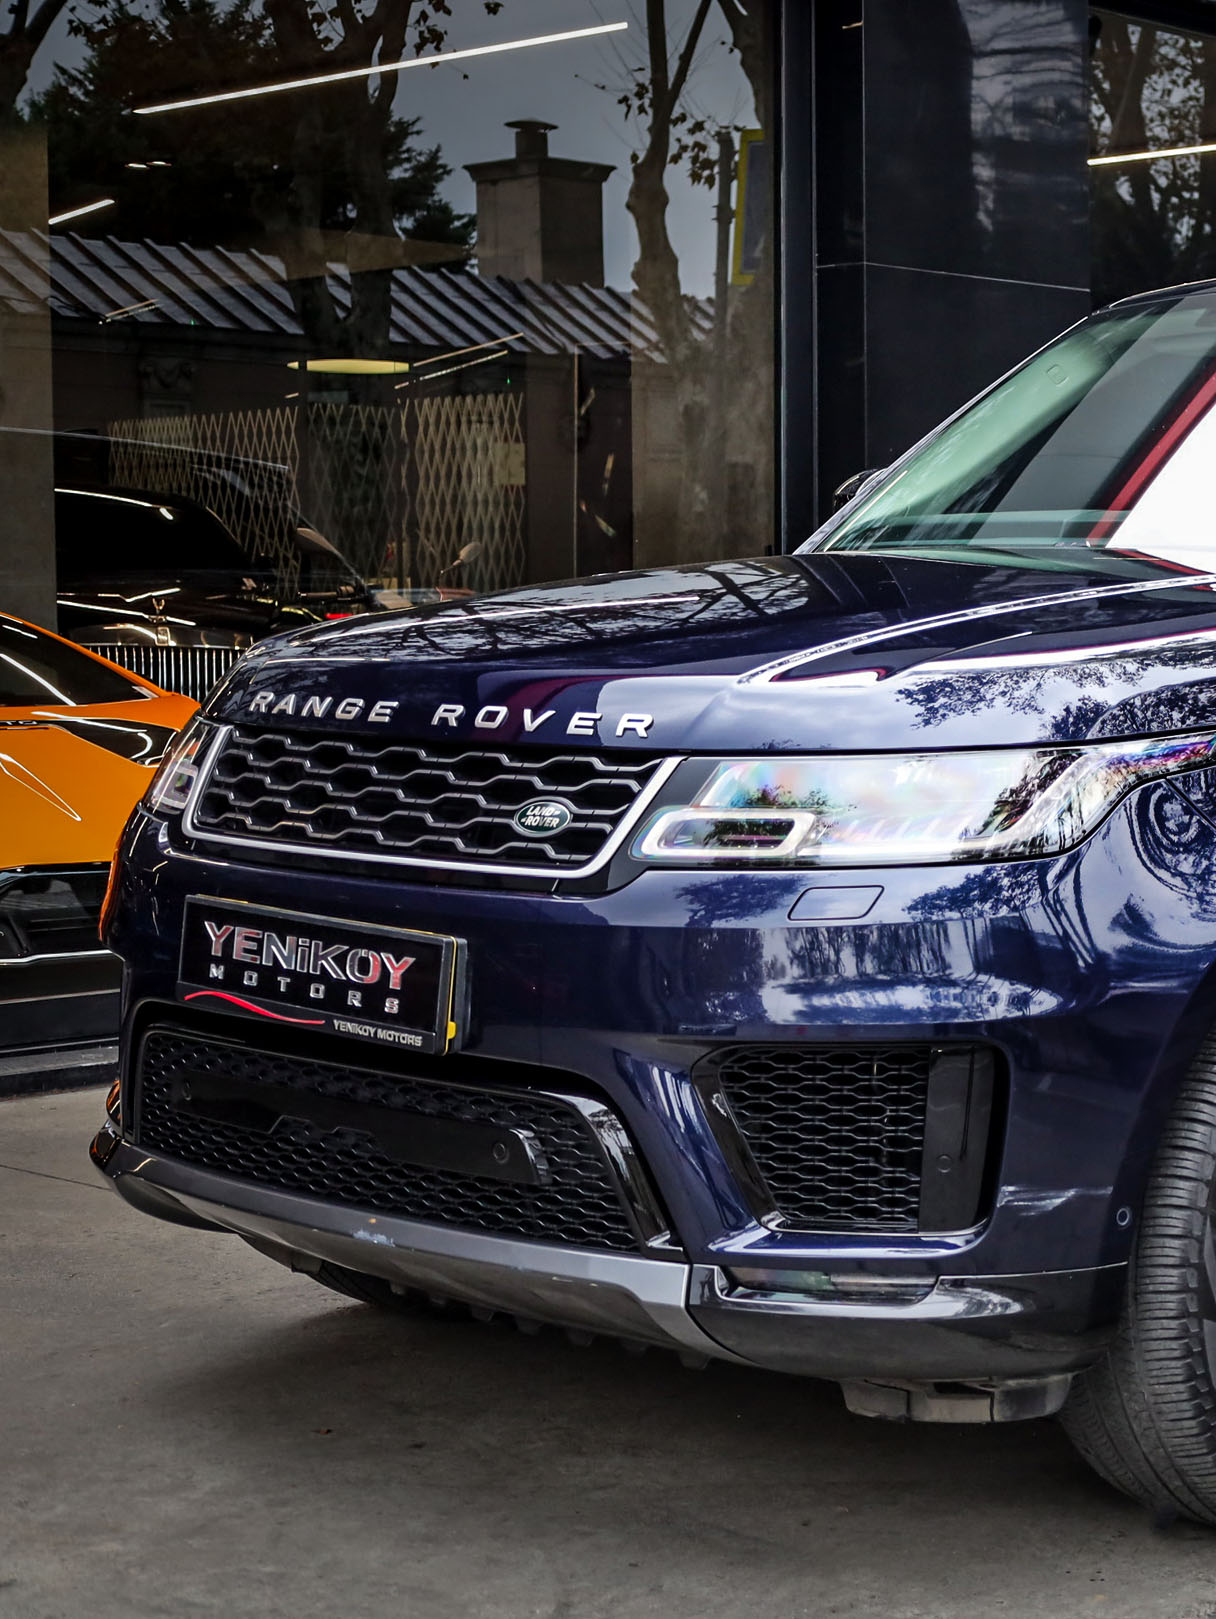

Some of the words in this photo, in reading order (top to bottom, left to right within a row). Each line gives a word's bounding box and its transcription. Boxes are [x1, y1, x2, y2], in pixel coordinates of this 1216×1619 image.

[249, 690, 400, 723] RANGE
[431, 703, 655, 738] ROVER
[527, 805, 556, 815] LAND
[525, 816, 560, 828] ROVER
[209, 963, 400, 1014] MOTORS
[377, 1028, 423, 1046] MOTORS
